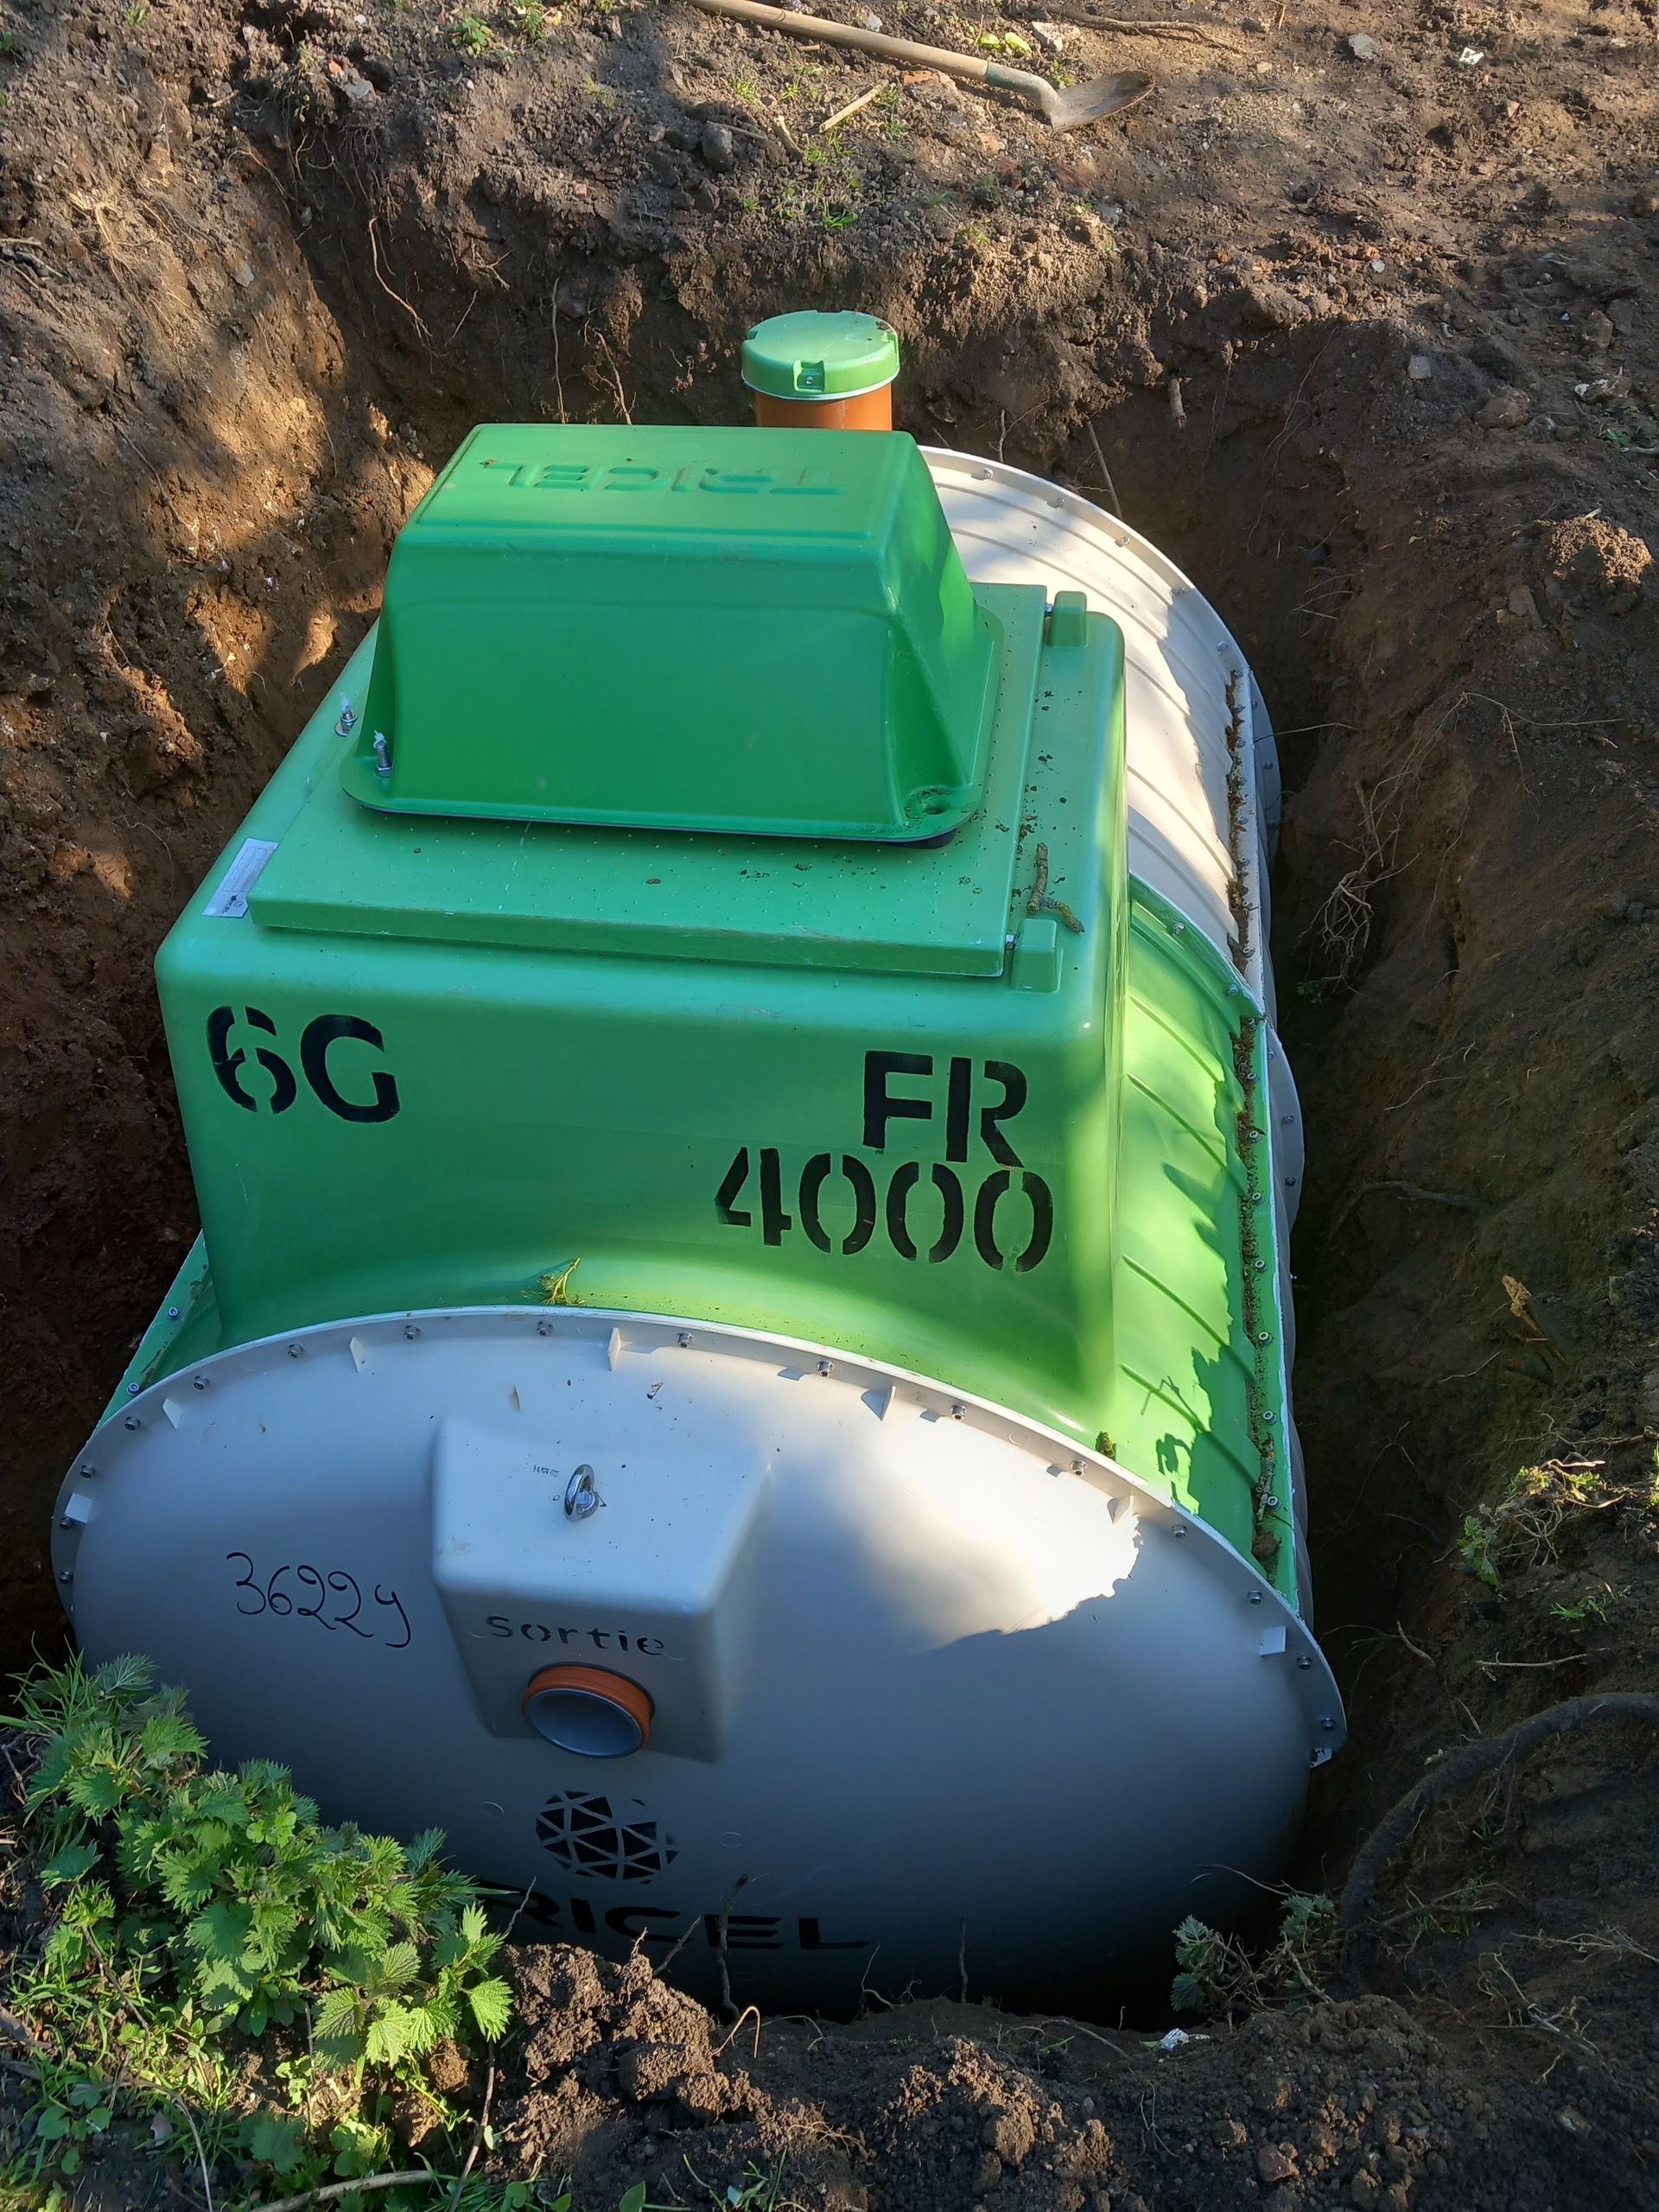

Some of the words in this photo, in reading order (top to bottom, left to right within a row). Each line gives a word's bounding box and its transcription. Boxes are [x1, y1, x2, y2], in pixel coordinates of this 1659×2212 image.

[481, 461, 849, 495] TRICEL
[207, 1005, 401, 1123] 6G
[862, 1050, 1028, 1168] FR
[715, 1146, 1054, 1273] 4000
[472, 1877, 873, 1951] RICEL
